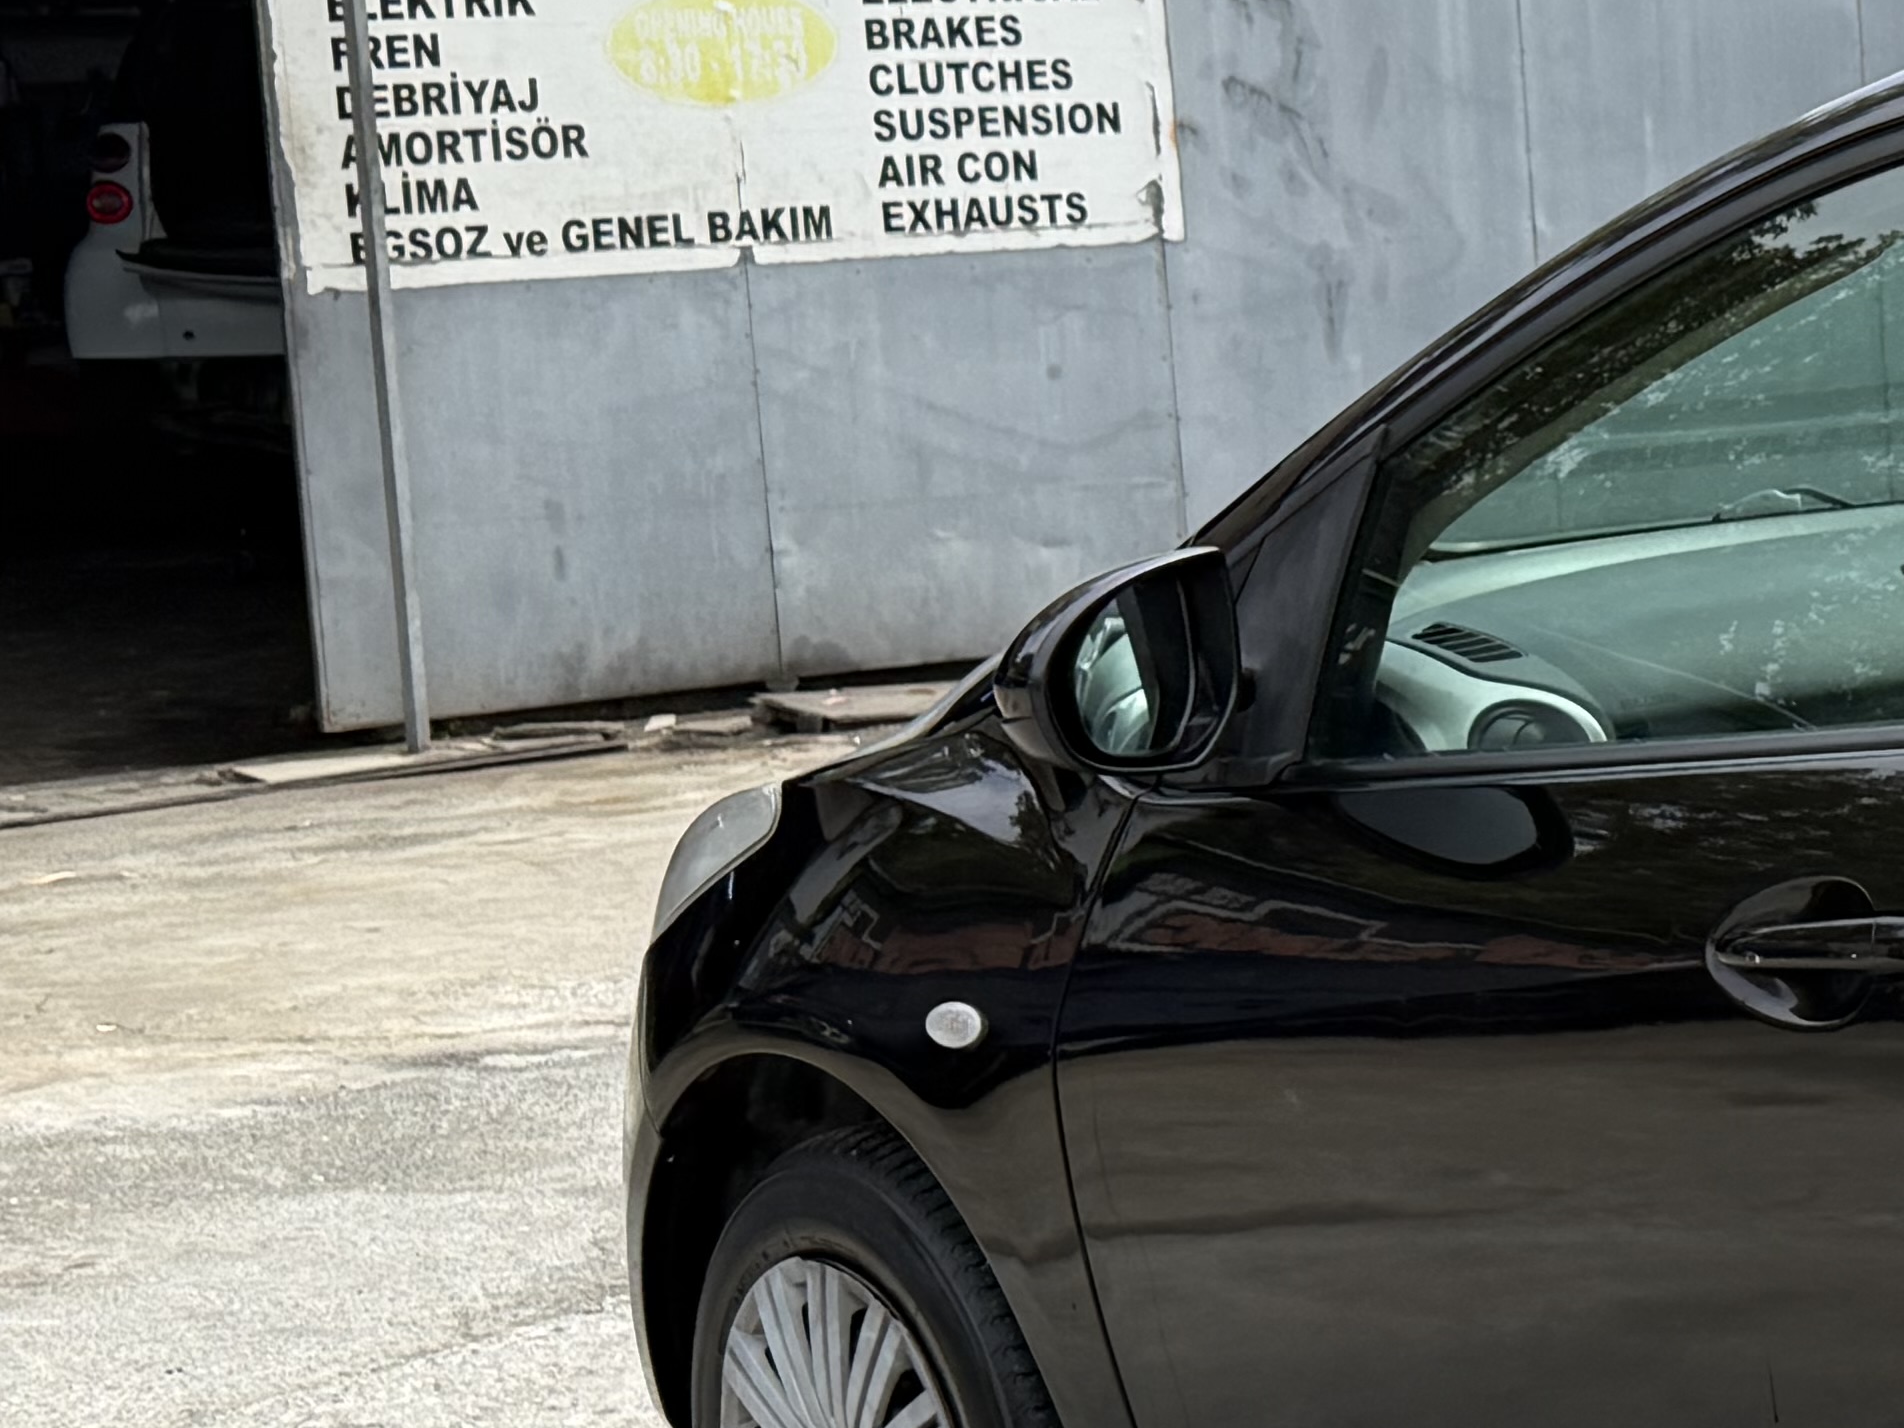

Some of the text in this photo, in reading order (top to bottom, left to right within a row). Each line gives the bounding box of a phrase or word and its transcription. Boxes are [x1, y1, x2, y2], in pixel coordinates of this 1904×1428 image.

[864, 14, 1022, 51] BRAKES
[869, 58, 1073, 96] CLUTCHES
[873, 101, 1121, 142] SUSPENSION
[878, 149, 1038, 188] AIR CON
[504, 229, 548, 258] ve
[561, 212, 695, 253] GENEL
[707, 204, 834, 245] BAKIM
[882, 191, 1088, 234] EXHAUSTS
